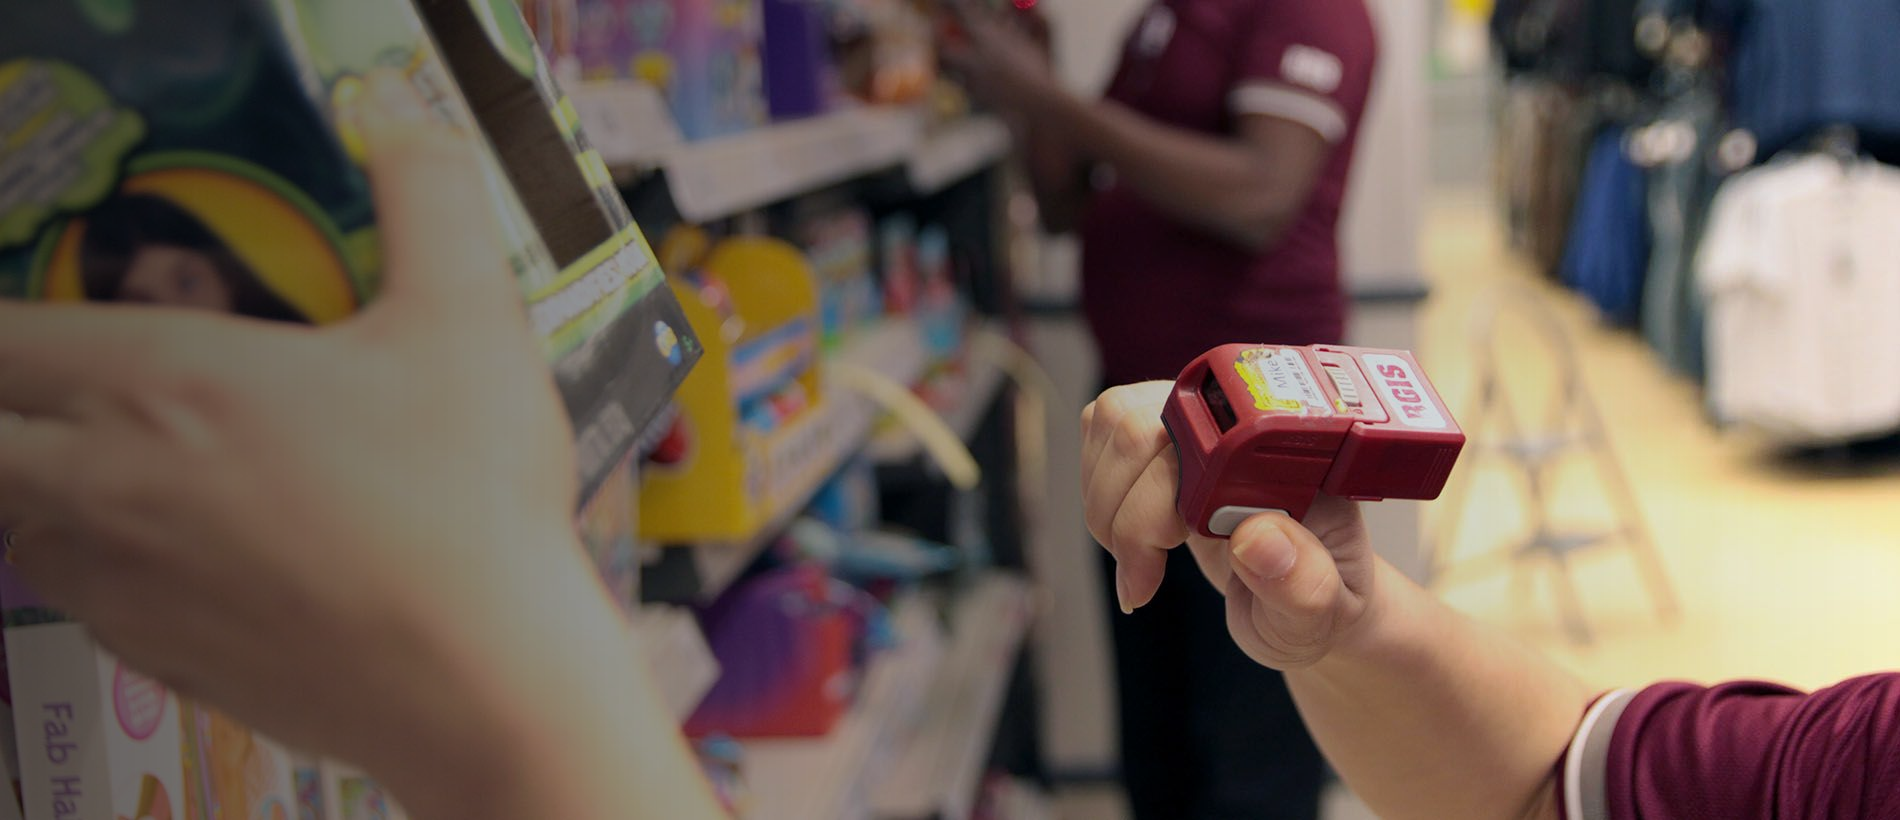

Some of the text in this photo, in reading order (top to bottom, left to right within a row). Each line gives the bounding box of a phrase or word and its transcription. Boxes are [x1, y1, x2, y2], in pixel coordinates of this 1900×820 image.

[1267, 360, 1289, 389] Mike
[1377, 364, 1426, 419] RGIS
[42, 702, 82, 820] Fab Ha
